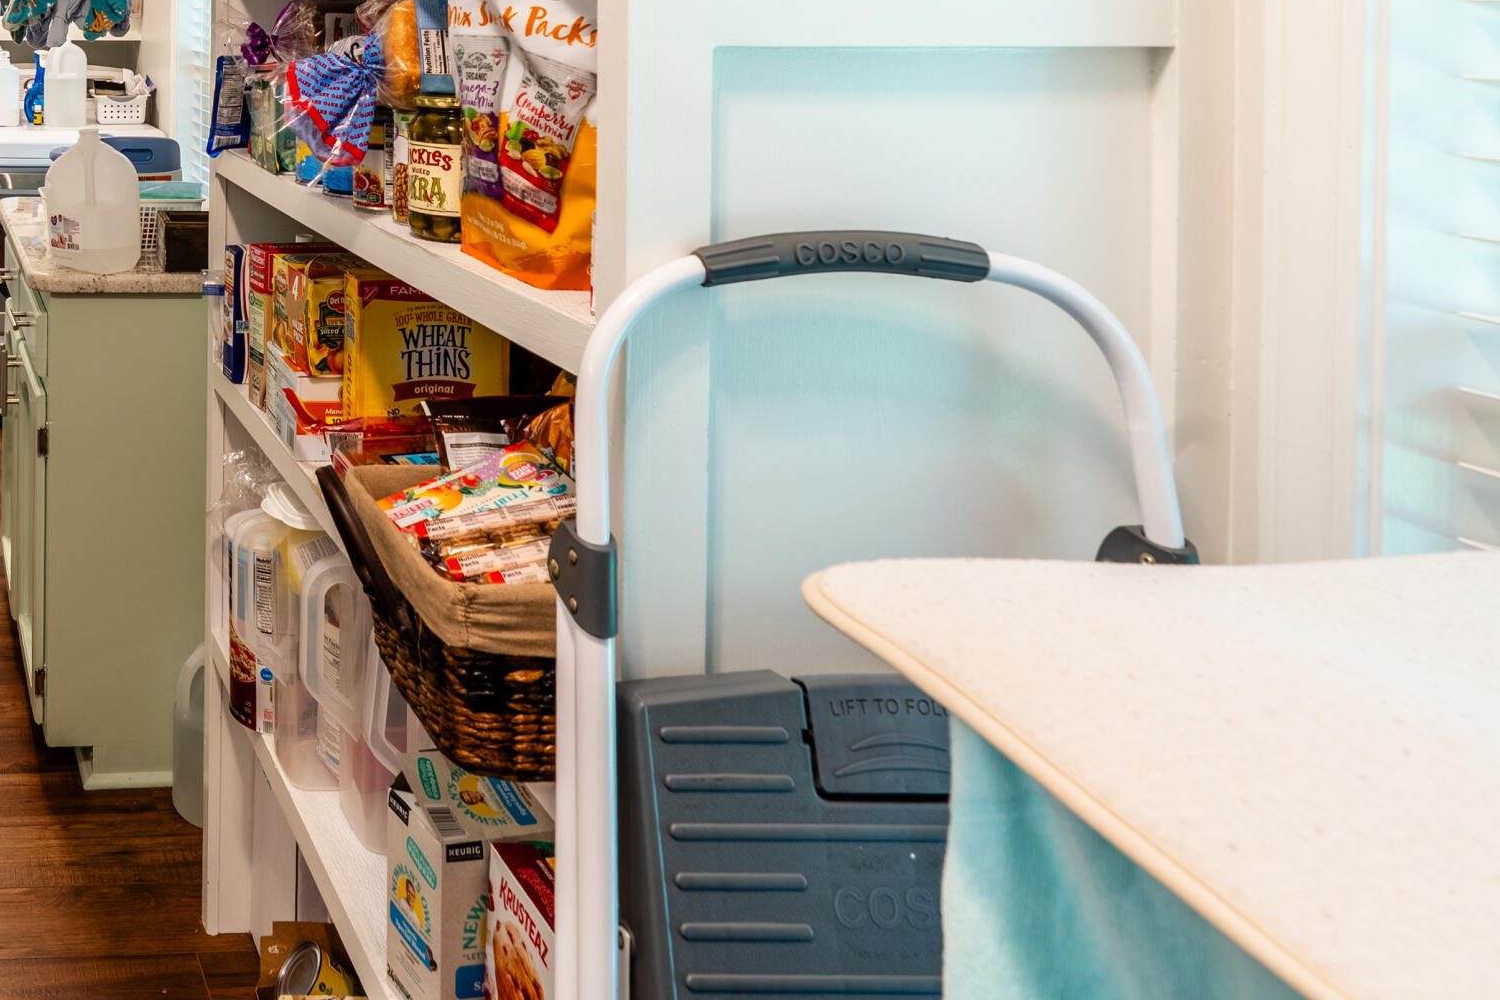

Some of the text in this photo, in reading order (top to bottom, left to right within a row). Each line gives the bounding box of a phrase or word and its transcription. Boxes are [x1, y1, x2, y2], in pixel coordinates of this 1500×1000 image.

[524, 6, 598, 48] Packs
[423, 30, 433, 74] Nutrition Facts
[465, 71, 488, 82] ORGANIC
[534, 90, 559, 112] ORGANIC
[515, 91, 576, 141] Cranberry
[794, 239, 906, 266] COSCO
[291, 275, 299, 300] 4
[395, 312, 414, 327] 100%
[415, 311, 444, 323] WHOLE
[398, 323, 472, 350] WHEAT
[414, 383, 455, 396] original
[494, 490, 529, 512] Fruit
[425, 518, 455, 528] Nutrition
[427, 524, 446, 532] Facts
[457, 551, 488, 563] Nutrition
[460, 560, 480, 568] Facts
[502, 570, 523, 579] Facts
[829, 699, 867, 716] LIFT
[876, 698, 900, 716] TO
[448, 846, 481, 858] KEURIG
[499, 876, 549, 969] KRUSTEAZ
